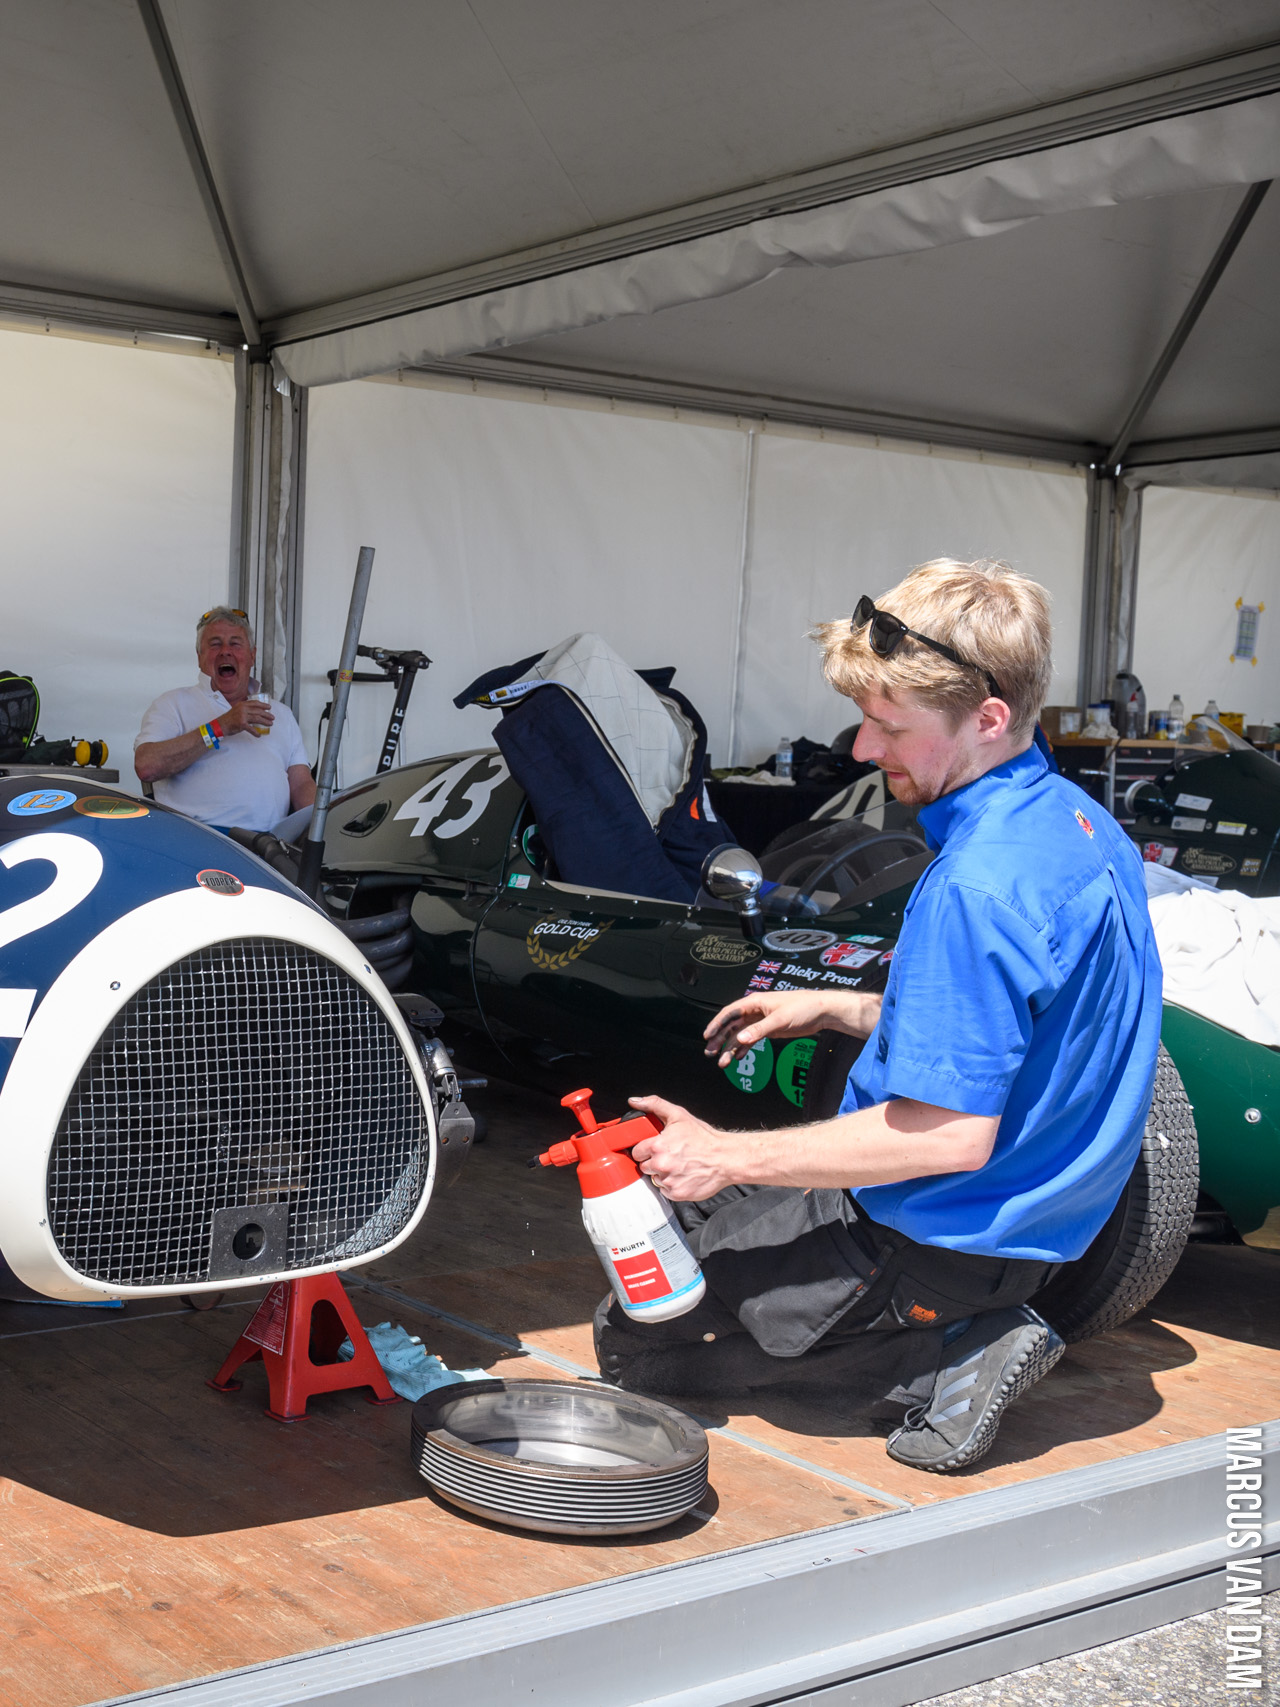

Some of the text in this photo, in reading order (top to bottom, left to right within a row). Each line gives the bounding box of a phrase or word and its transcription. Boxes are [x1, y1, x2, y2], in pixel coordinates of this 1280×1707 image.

[17, 793, 65, 809] 12
[393, 754, 511, 839] 43
[99, 799, 121, 814] 7
[205, 877, 236, 886] COOPER
[533, 922, 599, 940] GOLD CUP
[695, 945, 721, 954] GRAND
[737, 950, 759, 958] CARS
[714, 941, 749, 950] HISTORIC
[699, 952, 746, 963] ASSOCIATION
[781, 964, 862, 987] Dicky Prost
[737, 1050, 756, 1077] B
[740, 1077, 752, 1092] 12
